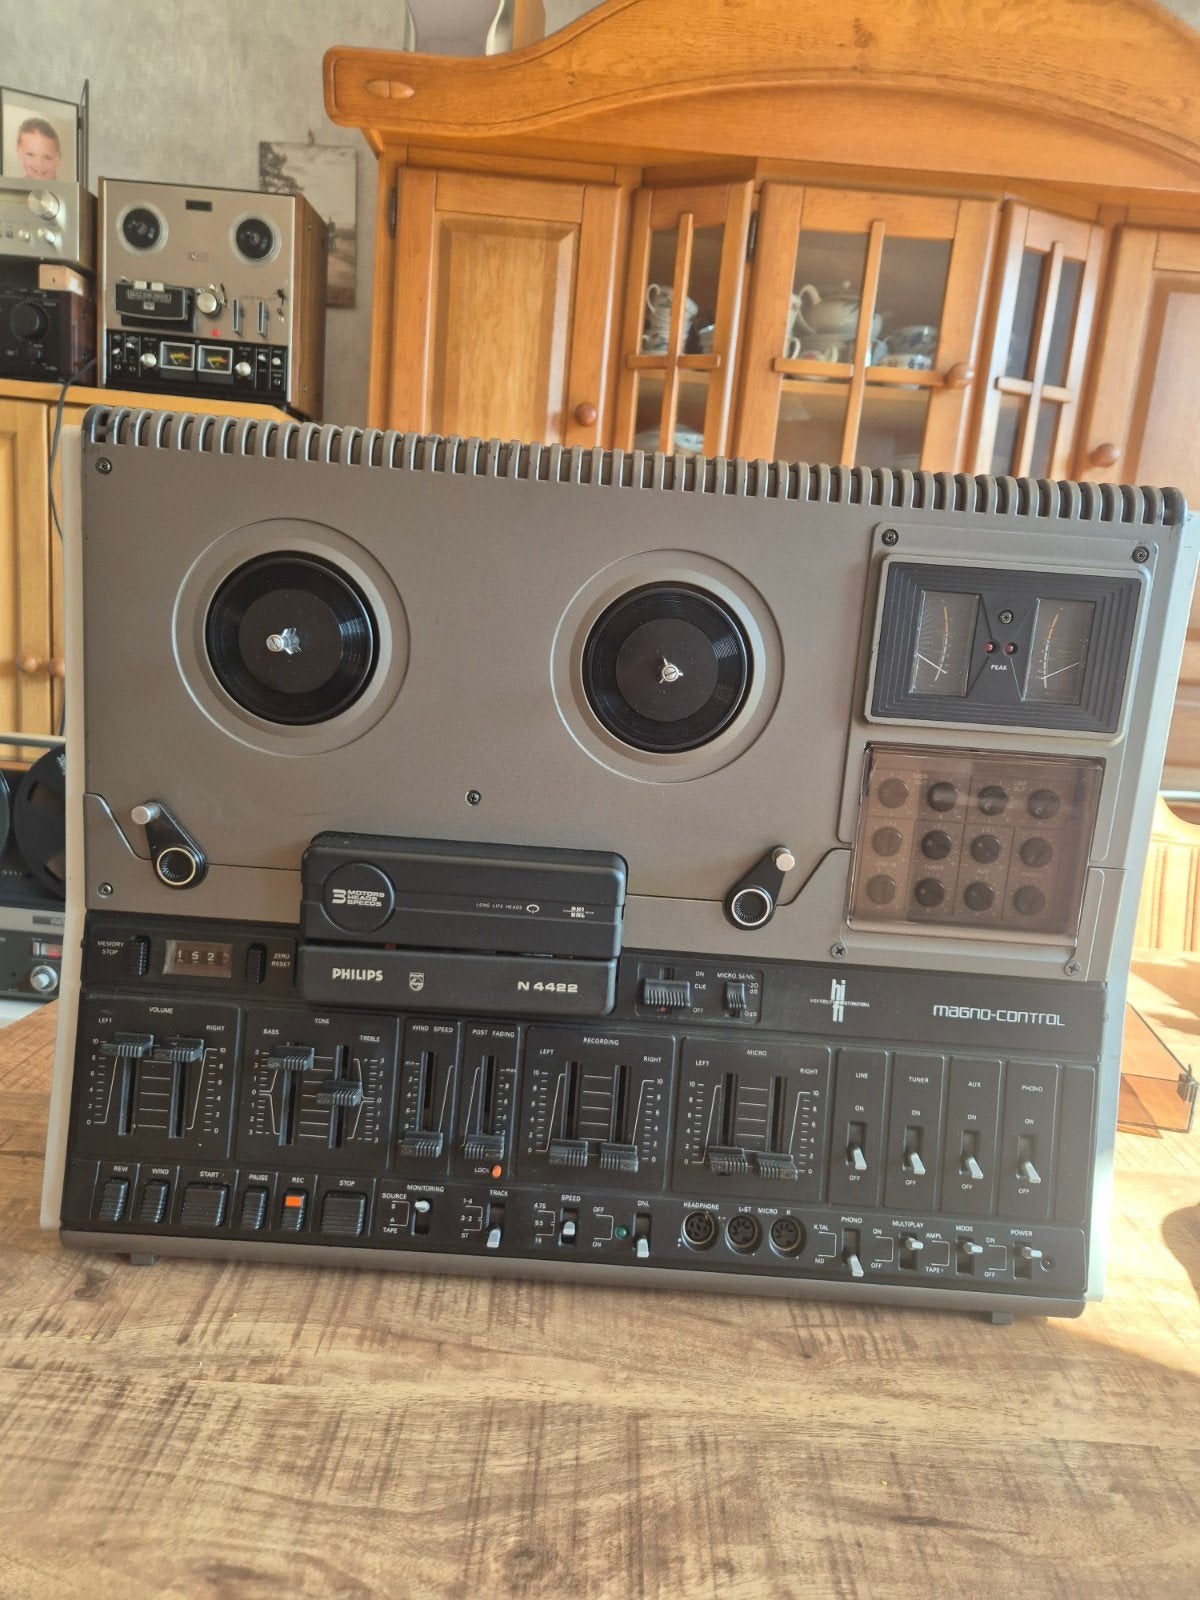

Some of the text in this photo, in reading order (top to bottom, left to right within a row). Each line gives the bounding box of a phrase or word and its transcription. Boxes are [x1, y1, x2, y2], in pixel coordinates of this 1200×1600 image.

[990, 663, 1008, 671] PEAK
[331, 888, 346, 904] 3
[347, 890, 385, 898] MOTORS
[332, 967, 383, 982] PHILIPS
[517, 980, 578, 994] N 4422
[493, 1030, 515, 1038] FADING
[583, 1037, 619, 1045] RECORDING
[113, 1165, 128, 1173] REW
[292, 1176, 304, 1184] REC
[339, 1179, 355, 1187] STOP
[407, 1185, 445, 1193] MONITORING
[382, 1192, 407, 1200] SOURCE
[561, 1194, 581, 1202] SPEED
[683, 1202, 719, 1210] HEADPHONE
[757, 1207, 778, 1215] MICRO
[841, 1216, 863, 1224] PHONO
[955, 1225, 973, 1233] MODE
[1011, 1229, 1033, 1237] POWER
